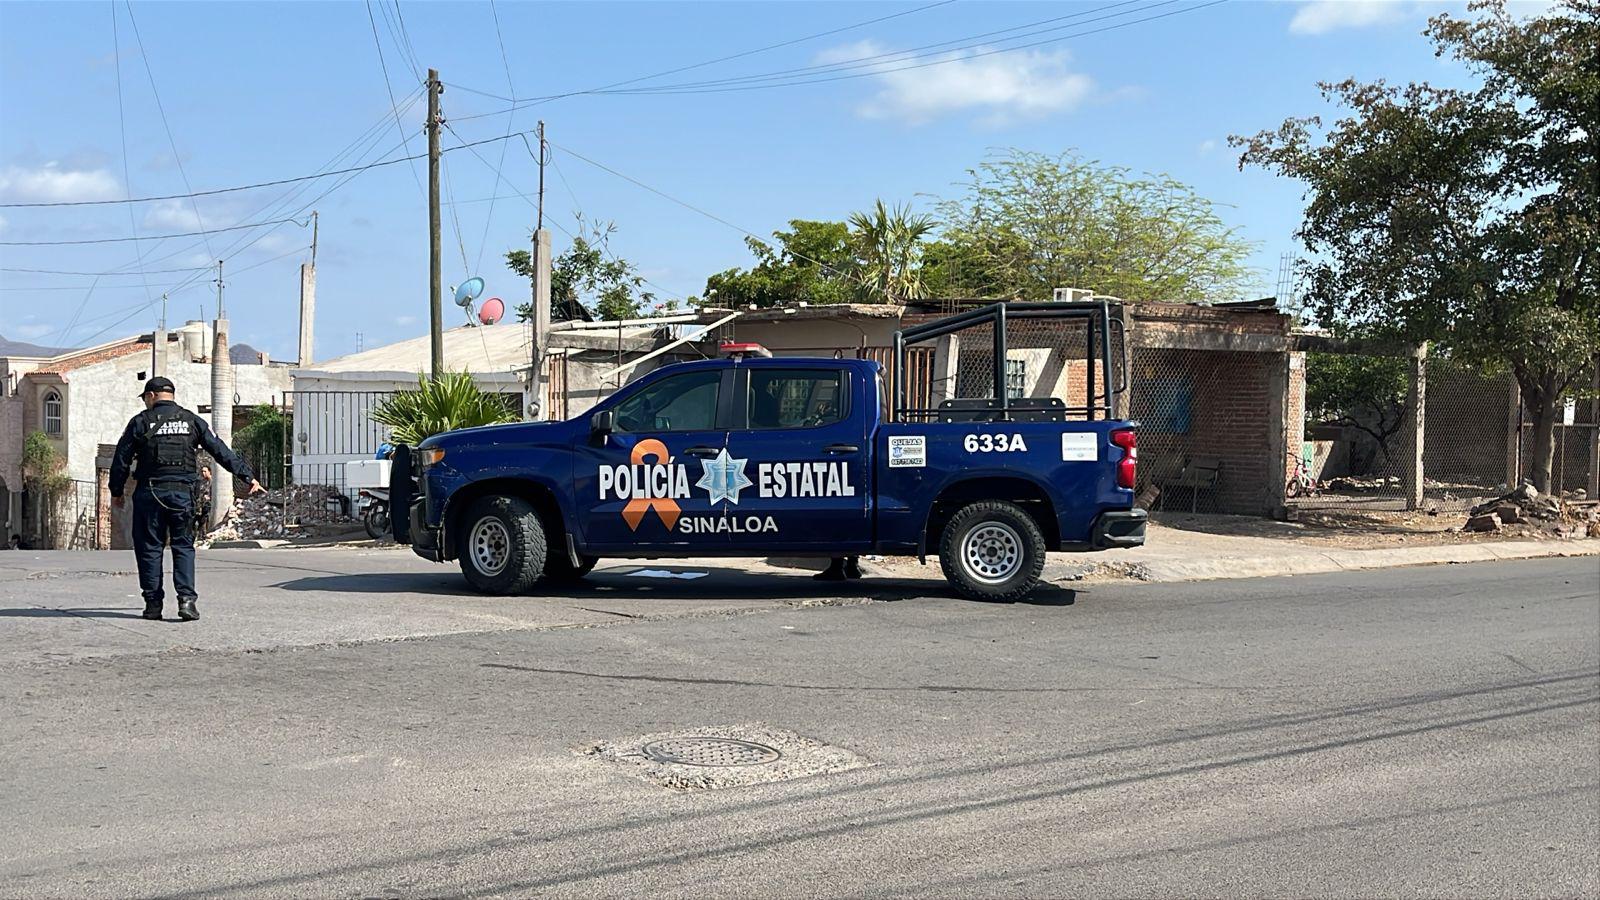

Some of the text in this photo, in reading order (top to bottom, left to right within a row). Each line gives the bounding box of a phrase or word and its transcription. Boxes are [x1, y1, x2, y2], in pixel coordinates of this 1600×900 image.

[150, 420, 189, 429] PLICÍA
[892, 438, 922, 446] QUEJAS
[964, 433, 1028, 453] 633A
[599, 456, 855, 500] POLICÍA ESTATAL
[679, 516, 779, 534] SINALOA
